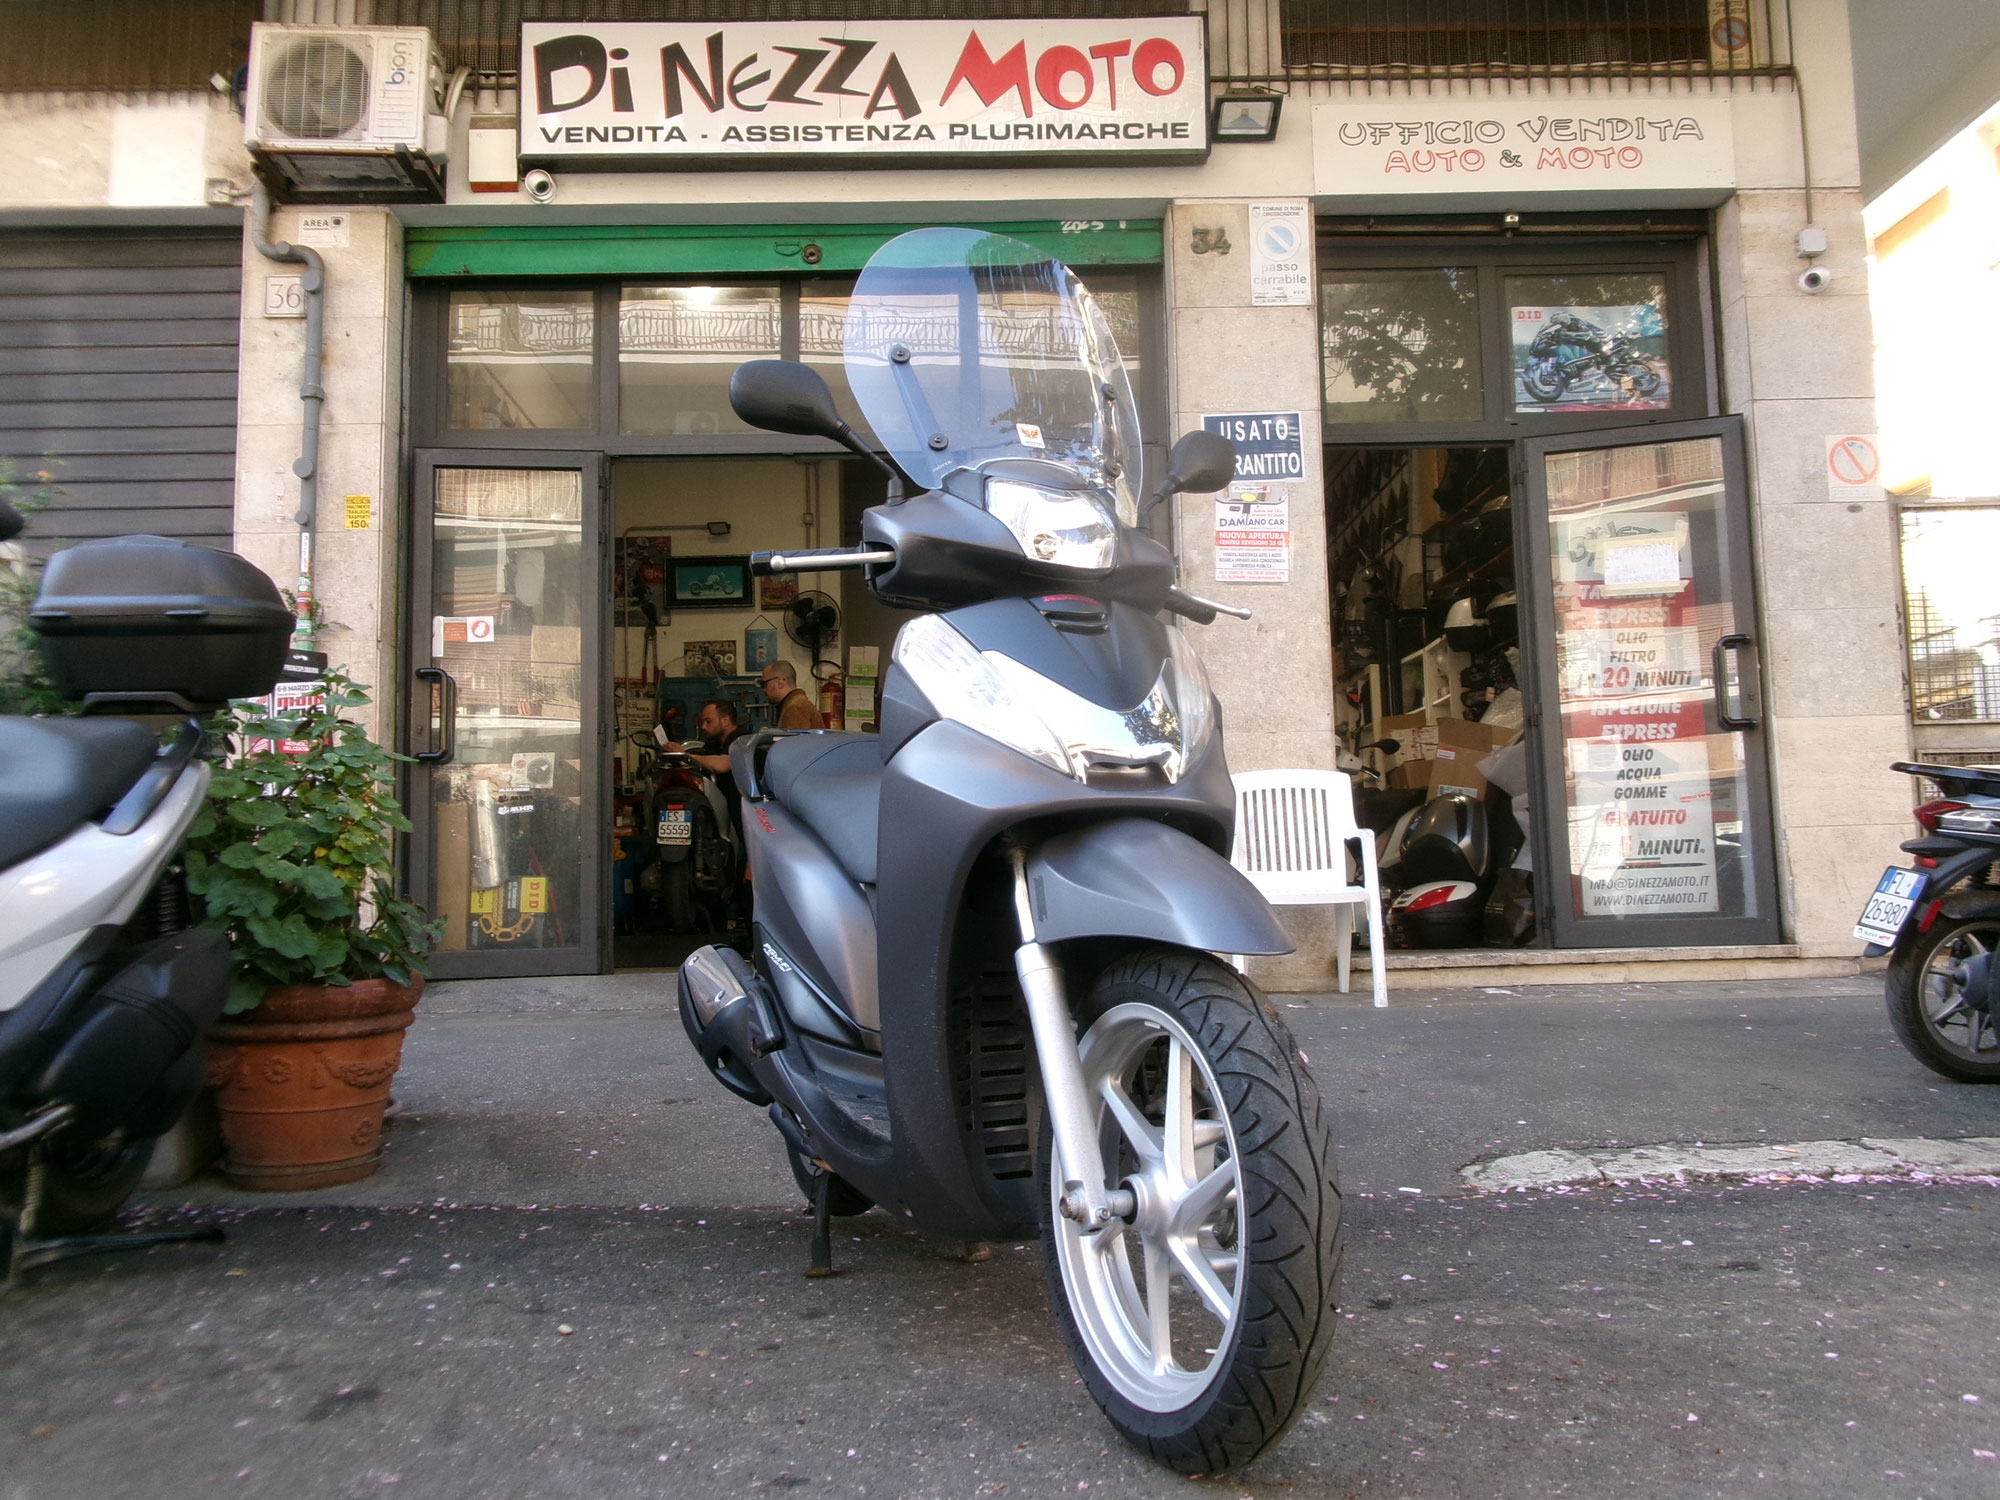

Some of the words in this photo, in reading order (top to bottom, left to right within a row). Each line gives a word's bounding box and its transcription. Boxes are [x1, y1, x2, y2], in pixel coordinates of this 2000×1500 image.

[939, 28, 1186, 119] MOTO
[539, 125, 688, 143] VENDITA
[721, 124, 936, 143] ASSISTENZA
[949, 122, 1190, 140] PLURIMARCHE
[1338, 119, 1505, 146] UFFICIO
[1516, 115, 1704, 143] VENDITA
[1385, 149, 1486, 173] AUTO
[1500, 149, 1523, 168] &
[1537, 146, 1643, 170] MOTO
[303, 219, 329, 227] AREA
[1191, 227, 1231, 255] 34
[1262, 263, 1298, 275] passo
[1253, 274, 1307, 285] carrabile
[268, 283, 301, 309] 36
[1220, 418, 1288, 442] USATO
[1233, 452, 1301, 476] RANTITO
[1219, 518, 1266, 527] DAMIANO
[1268, 518, 1285, 526] CAR
[1219, 532, 1247, 540] NUOVA
[1248, 532, 1285, 540] APERTURA
[1616, 631, 1649, 645] OLIO
[1609, 650, 1656, 663] FILTRO
[1602, 666, 1630, 688] 20
[1634, 670, 1693, 687] MINUTI
[1601, 722, 1678, 741] EXPRESS
[1622, 749, 1654, 762] OLIO
[1616, 767, 1662, 782] ACQUA
[1614, 786, 1668, 800] GOMME
[1605, 809, 1687, 826] GRATUITO
[659, 824, 690, 836] 55559
[1590, 875, 1711, 892] INFO@DINEZZAMOTO.IT
[1593, 892, 1709, 907] WWW.DINEZZAMOTO.IT
[1864, 898, 1908, 926] 26980
